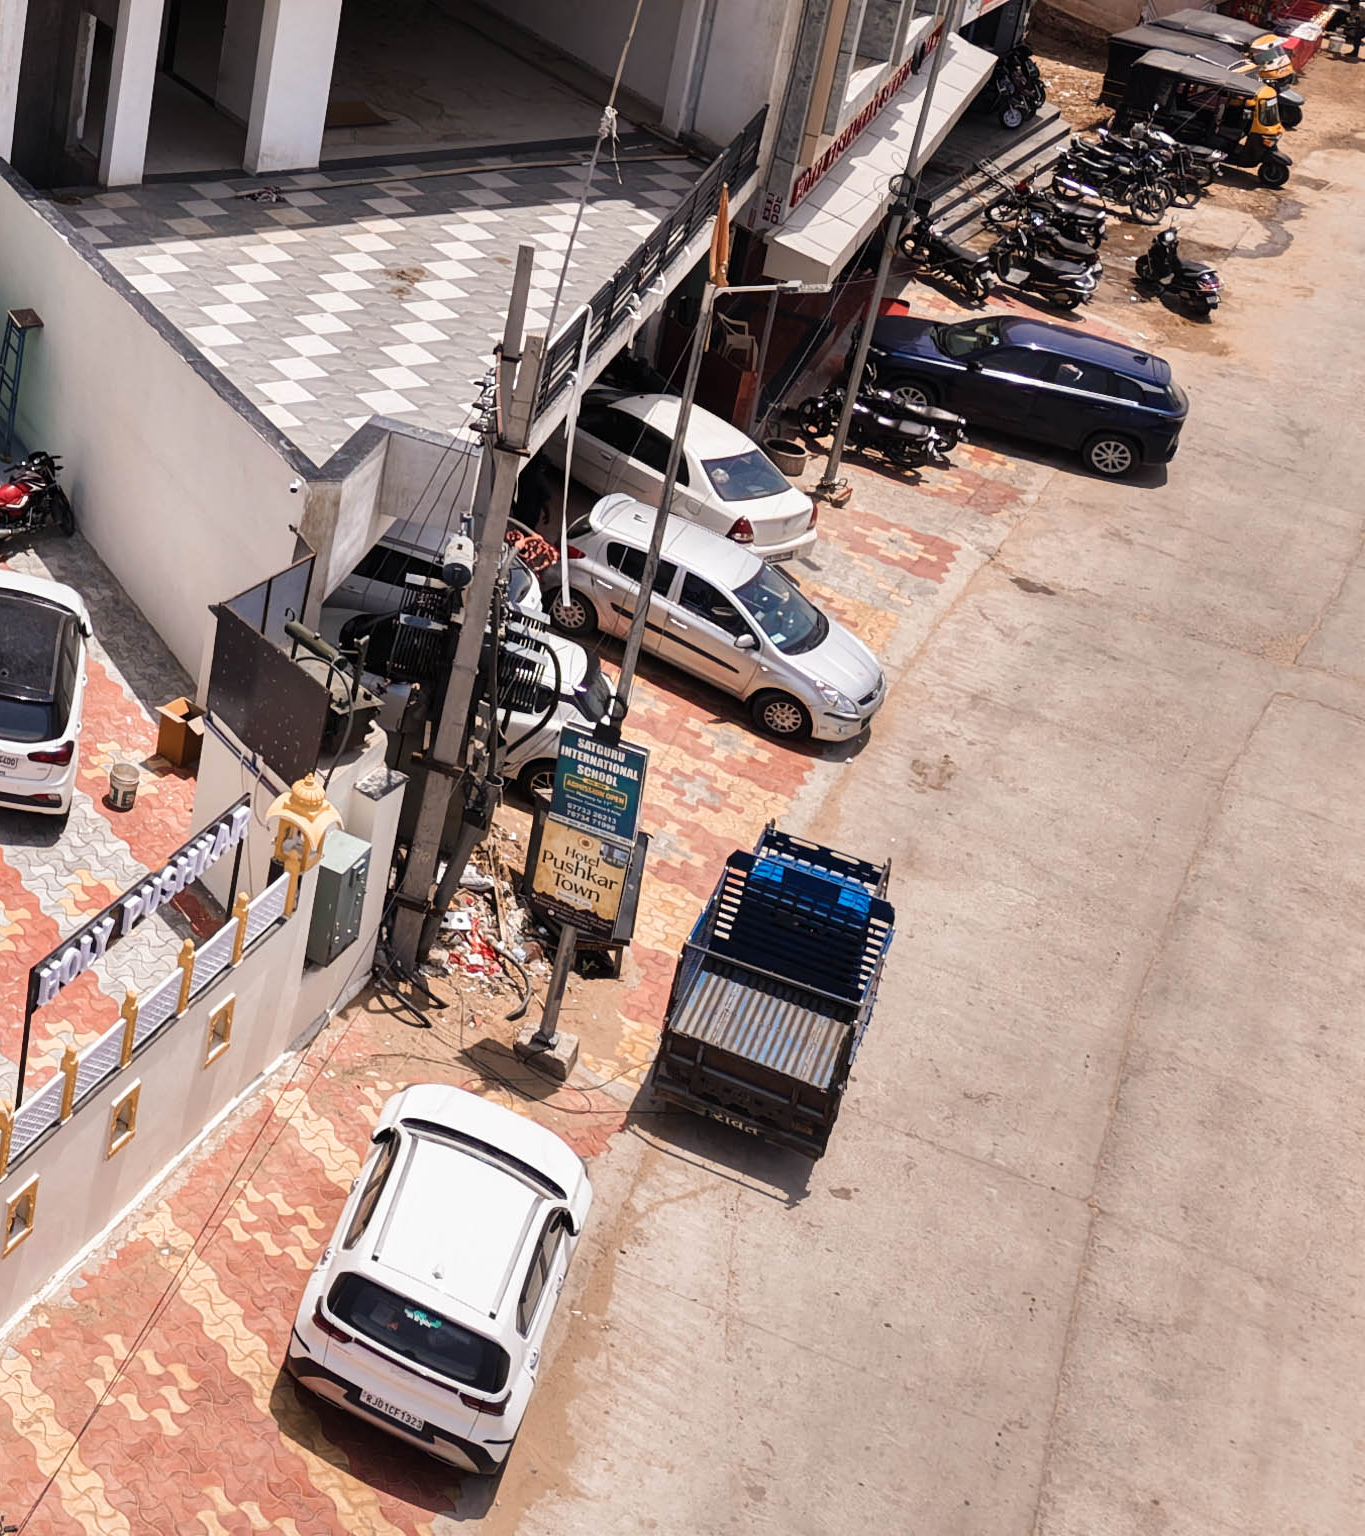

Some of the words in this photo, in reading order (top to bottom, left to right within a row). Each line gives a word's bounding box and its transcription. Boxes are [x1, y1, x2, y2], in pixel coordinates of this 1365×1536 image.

[560, 745, 639, 781] INTERNATIONAL
[577, 737, 626, 763] SATGURU
[577, 764, 618, 787] SCHOOL
[542, 849, 619, 890] Pushkar
[564, 846, 600, 868] Hotel
[552, 870, 601, 903] Town
[36, 917, 115, 1006] HOLY
[121, 805, 251, 937] PUSHKAR
